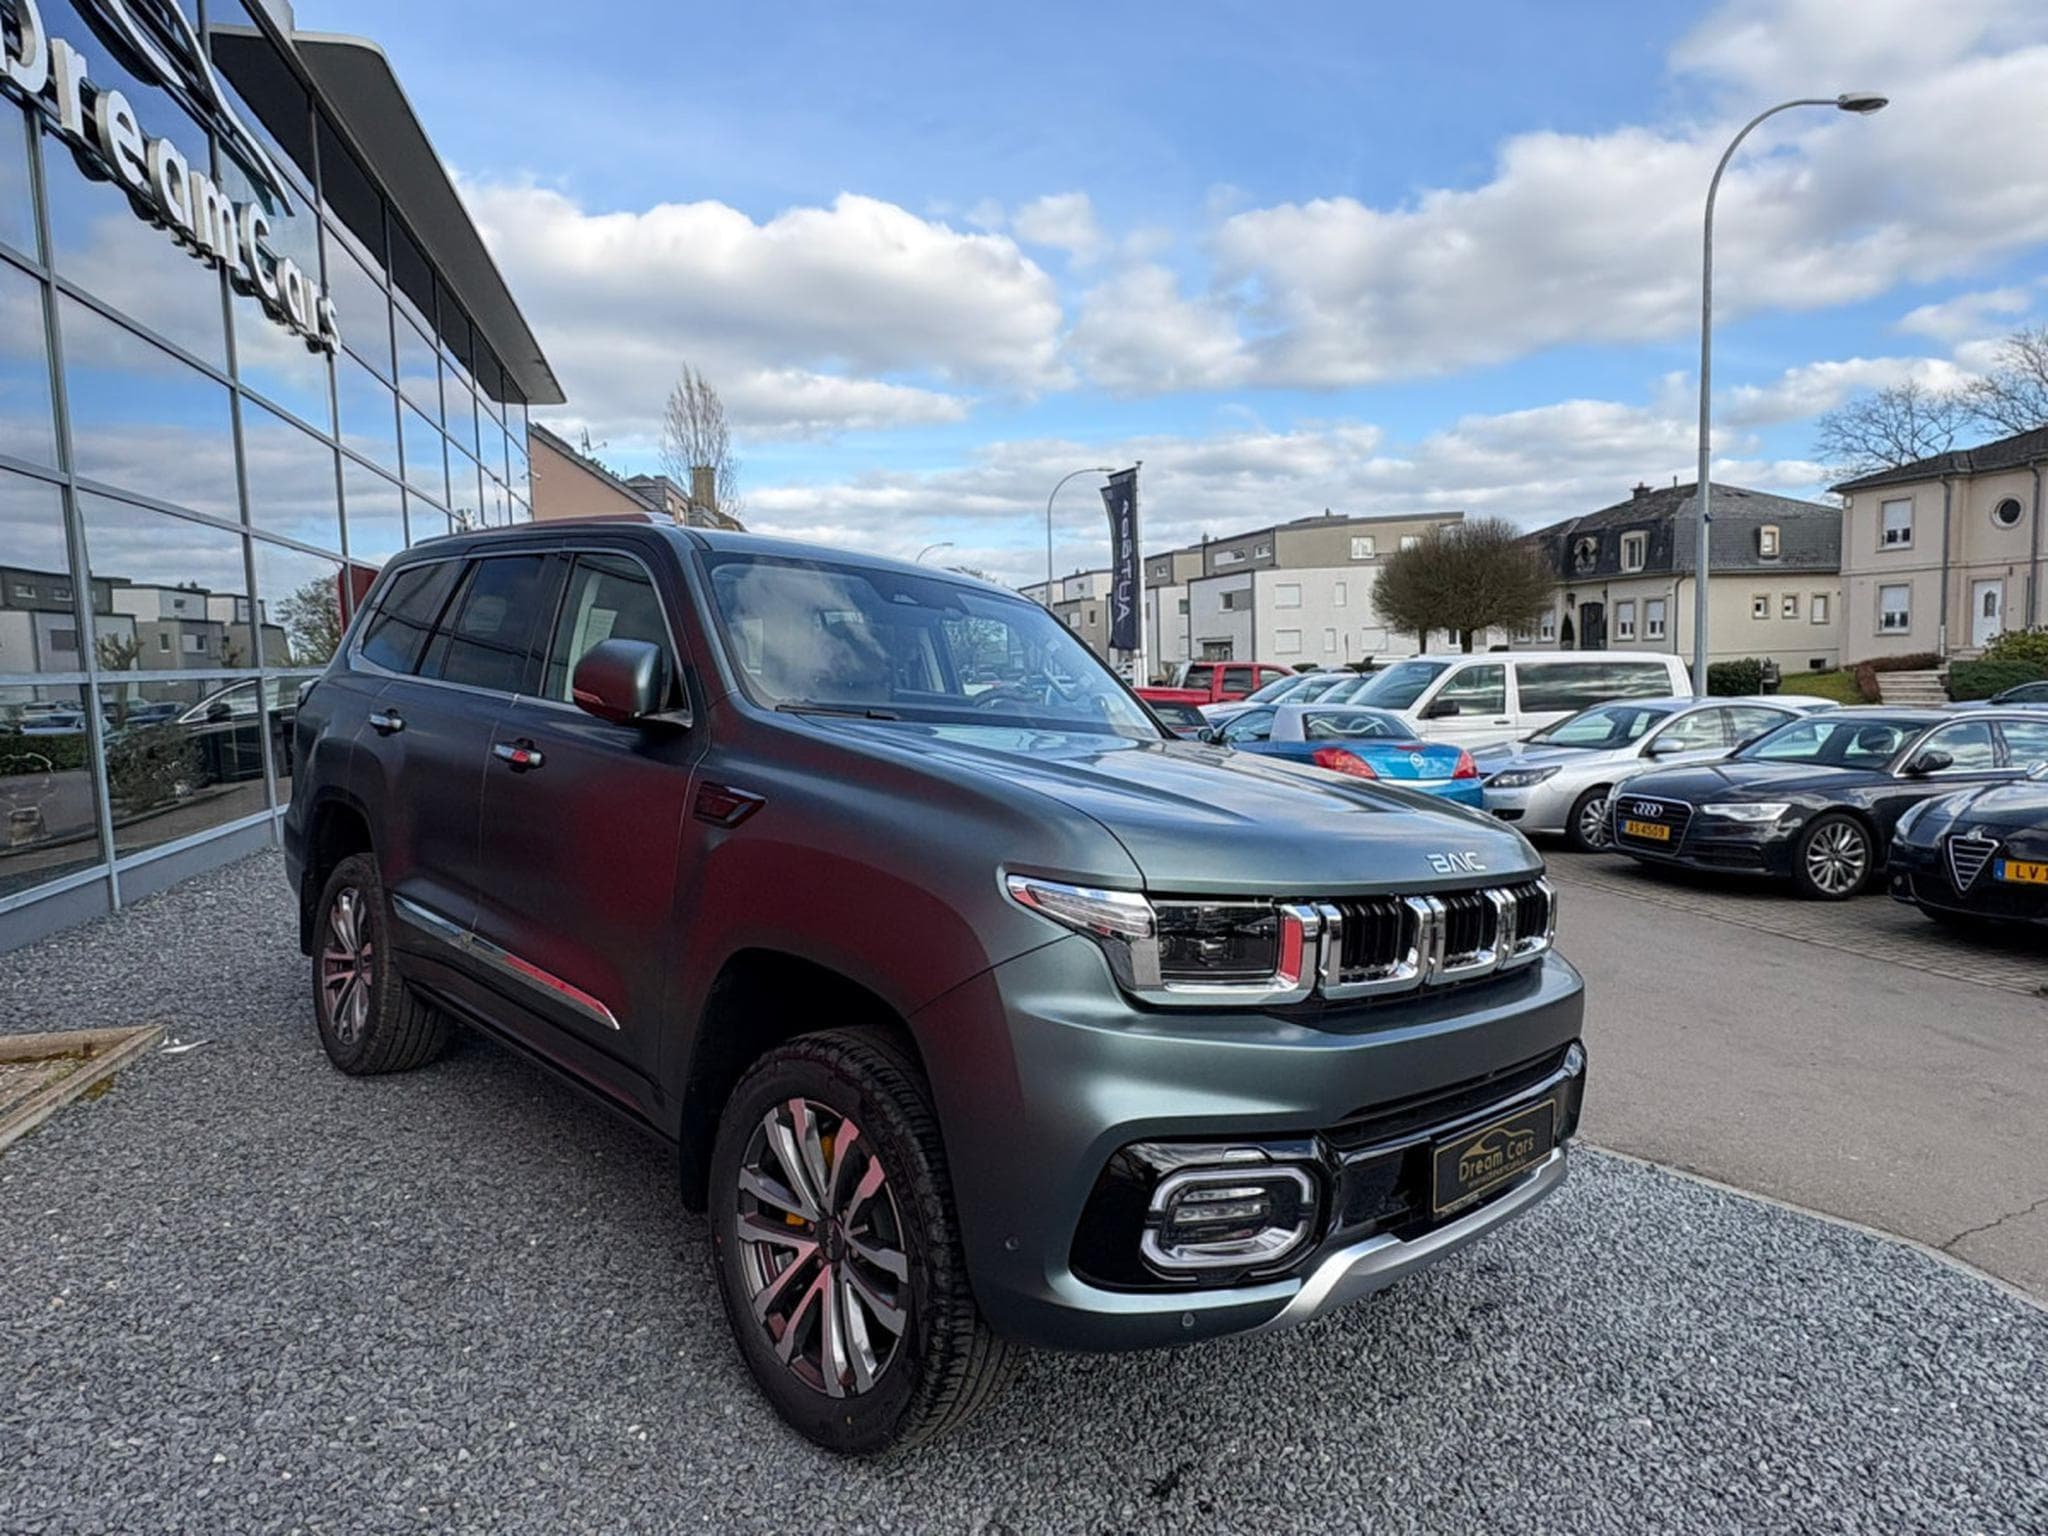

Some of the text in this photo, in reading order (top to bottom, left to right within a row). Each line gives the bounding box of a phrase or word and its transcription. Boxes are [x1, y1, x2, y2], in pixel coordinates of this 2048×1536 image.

[1426, 851, 1487, 874] BAIC
[1458, 1151, 1503, 1183] Dream
[1507, 1136, 1535, 1160] Cars
